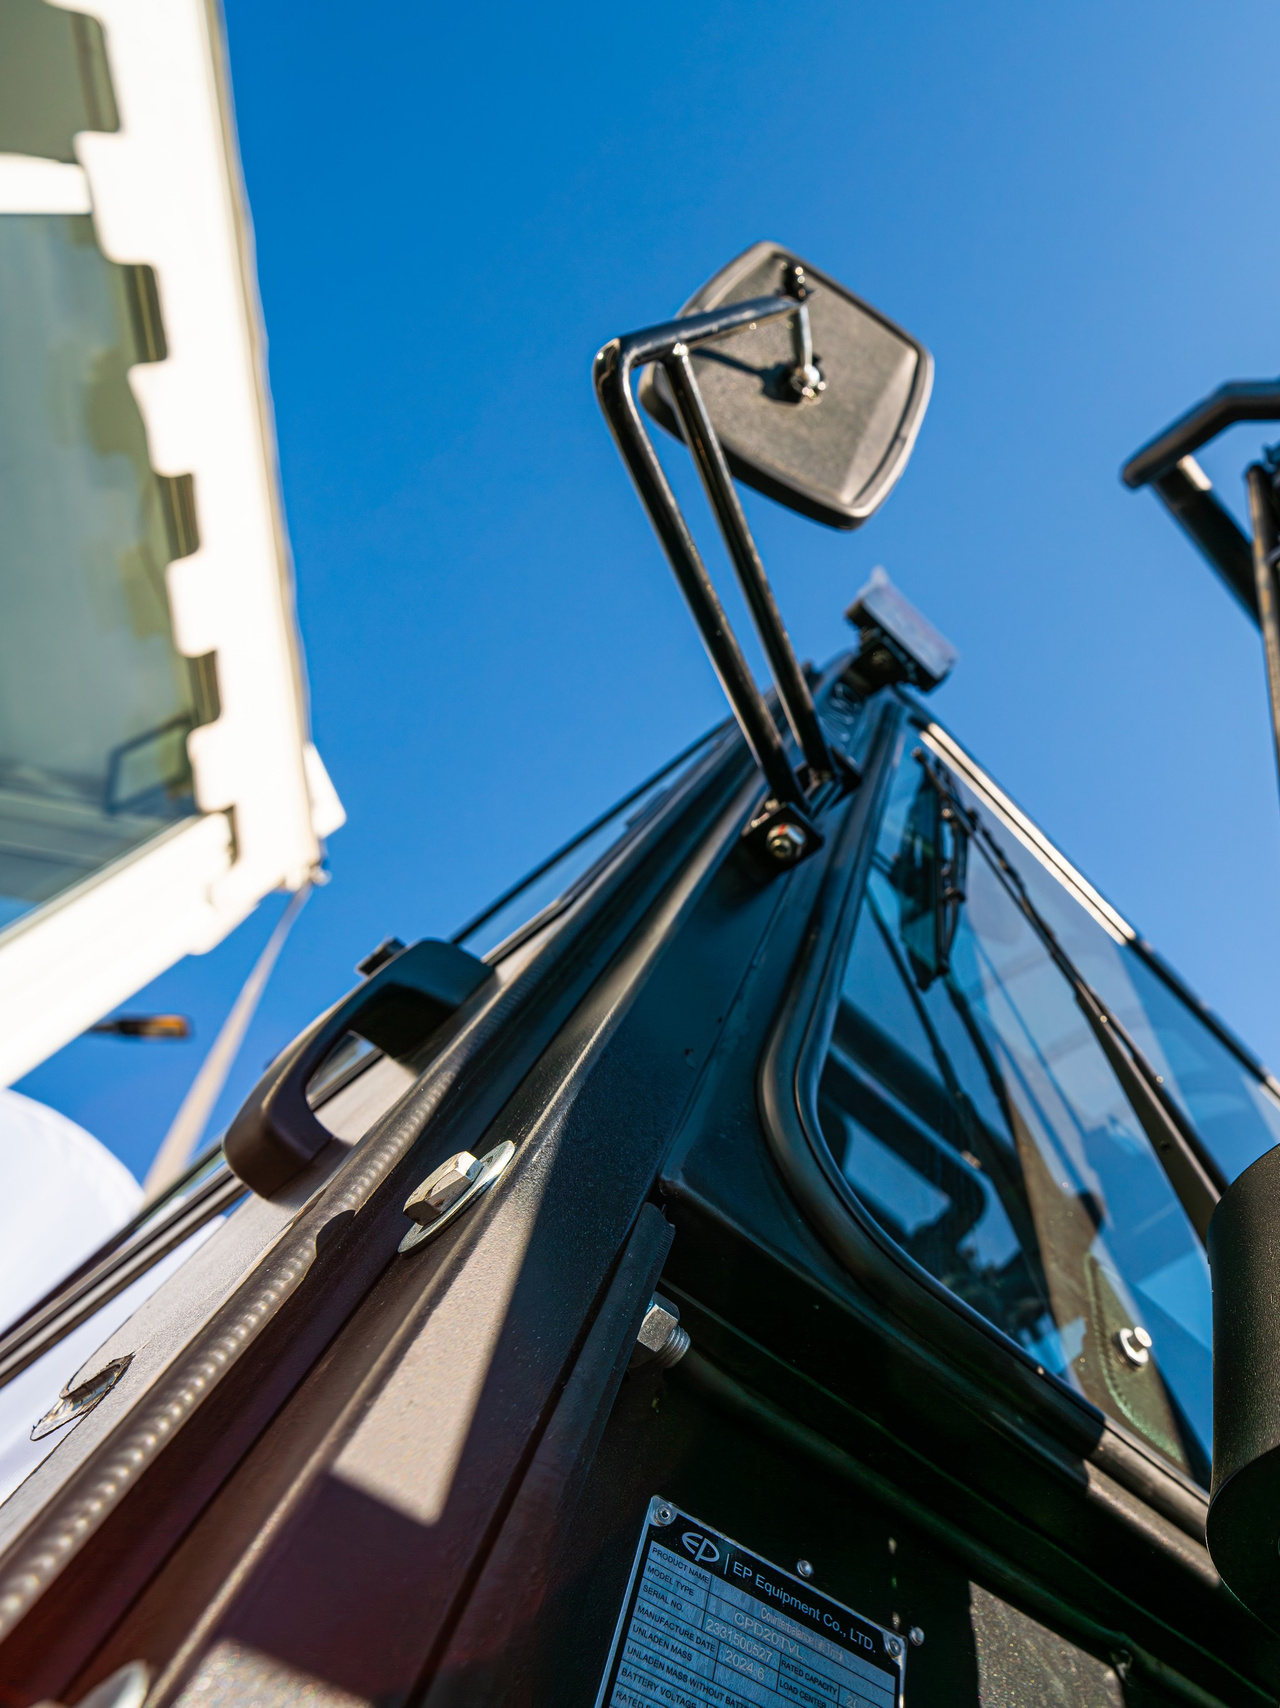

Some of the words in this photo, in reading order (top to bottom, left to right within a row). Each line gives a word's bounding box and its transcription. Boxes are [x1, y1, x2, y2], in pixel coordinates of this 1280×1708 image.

[647, 1565, 674, 1586] MODEL
[675, 1579, 695, 1596] TYPE
[651, 1547, 688, 1571] PRODUCT
[688, 1565, 710, 1584] NAME
[642, 1584, 670, 1605] SERIAL
[670, 1599, 684, 1612] NO.
[732, 1561, 753, 1579] EP
[755, 1573, 820, 1621] Equipment
[823, 1613, 847, 1638] Co.,
[850, 1628, 877, 1653] LTD.
[632, 1624, 670, 1650] UNLADEN
[670, 1645, 693, 1662] MASS
[637, 1605, 695, 1641] MANUFACTURE
[695, 1636, 716, 1653] DATE
[734, 1612, 803, 1660] CPD20TVL
[621, 1667, 659, 1692] BATTERY
[626, 1645, 665, 1671] UNLADEN
[665, 1665, 688, 1683] MASS
[689, 1677, 725, 1700] WITHOUT
[779, 1680, 799, 1695] LOAD
[780, 1659, 804, 1677] RATED
[804, 1672, 837, 1695] CAPACITY
